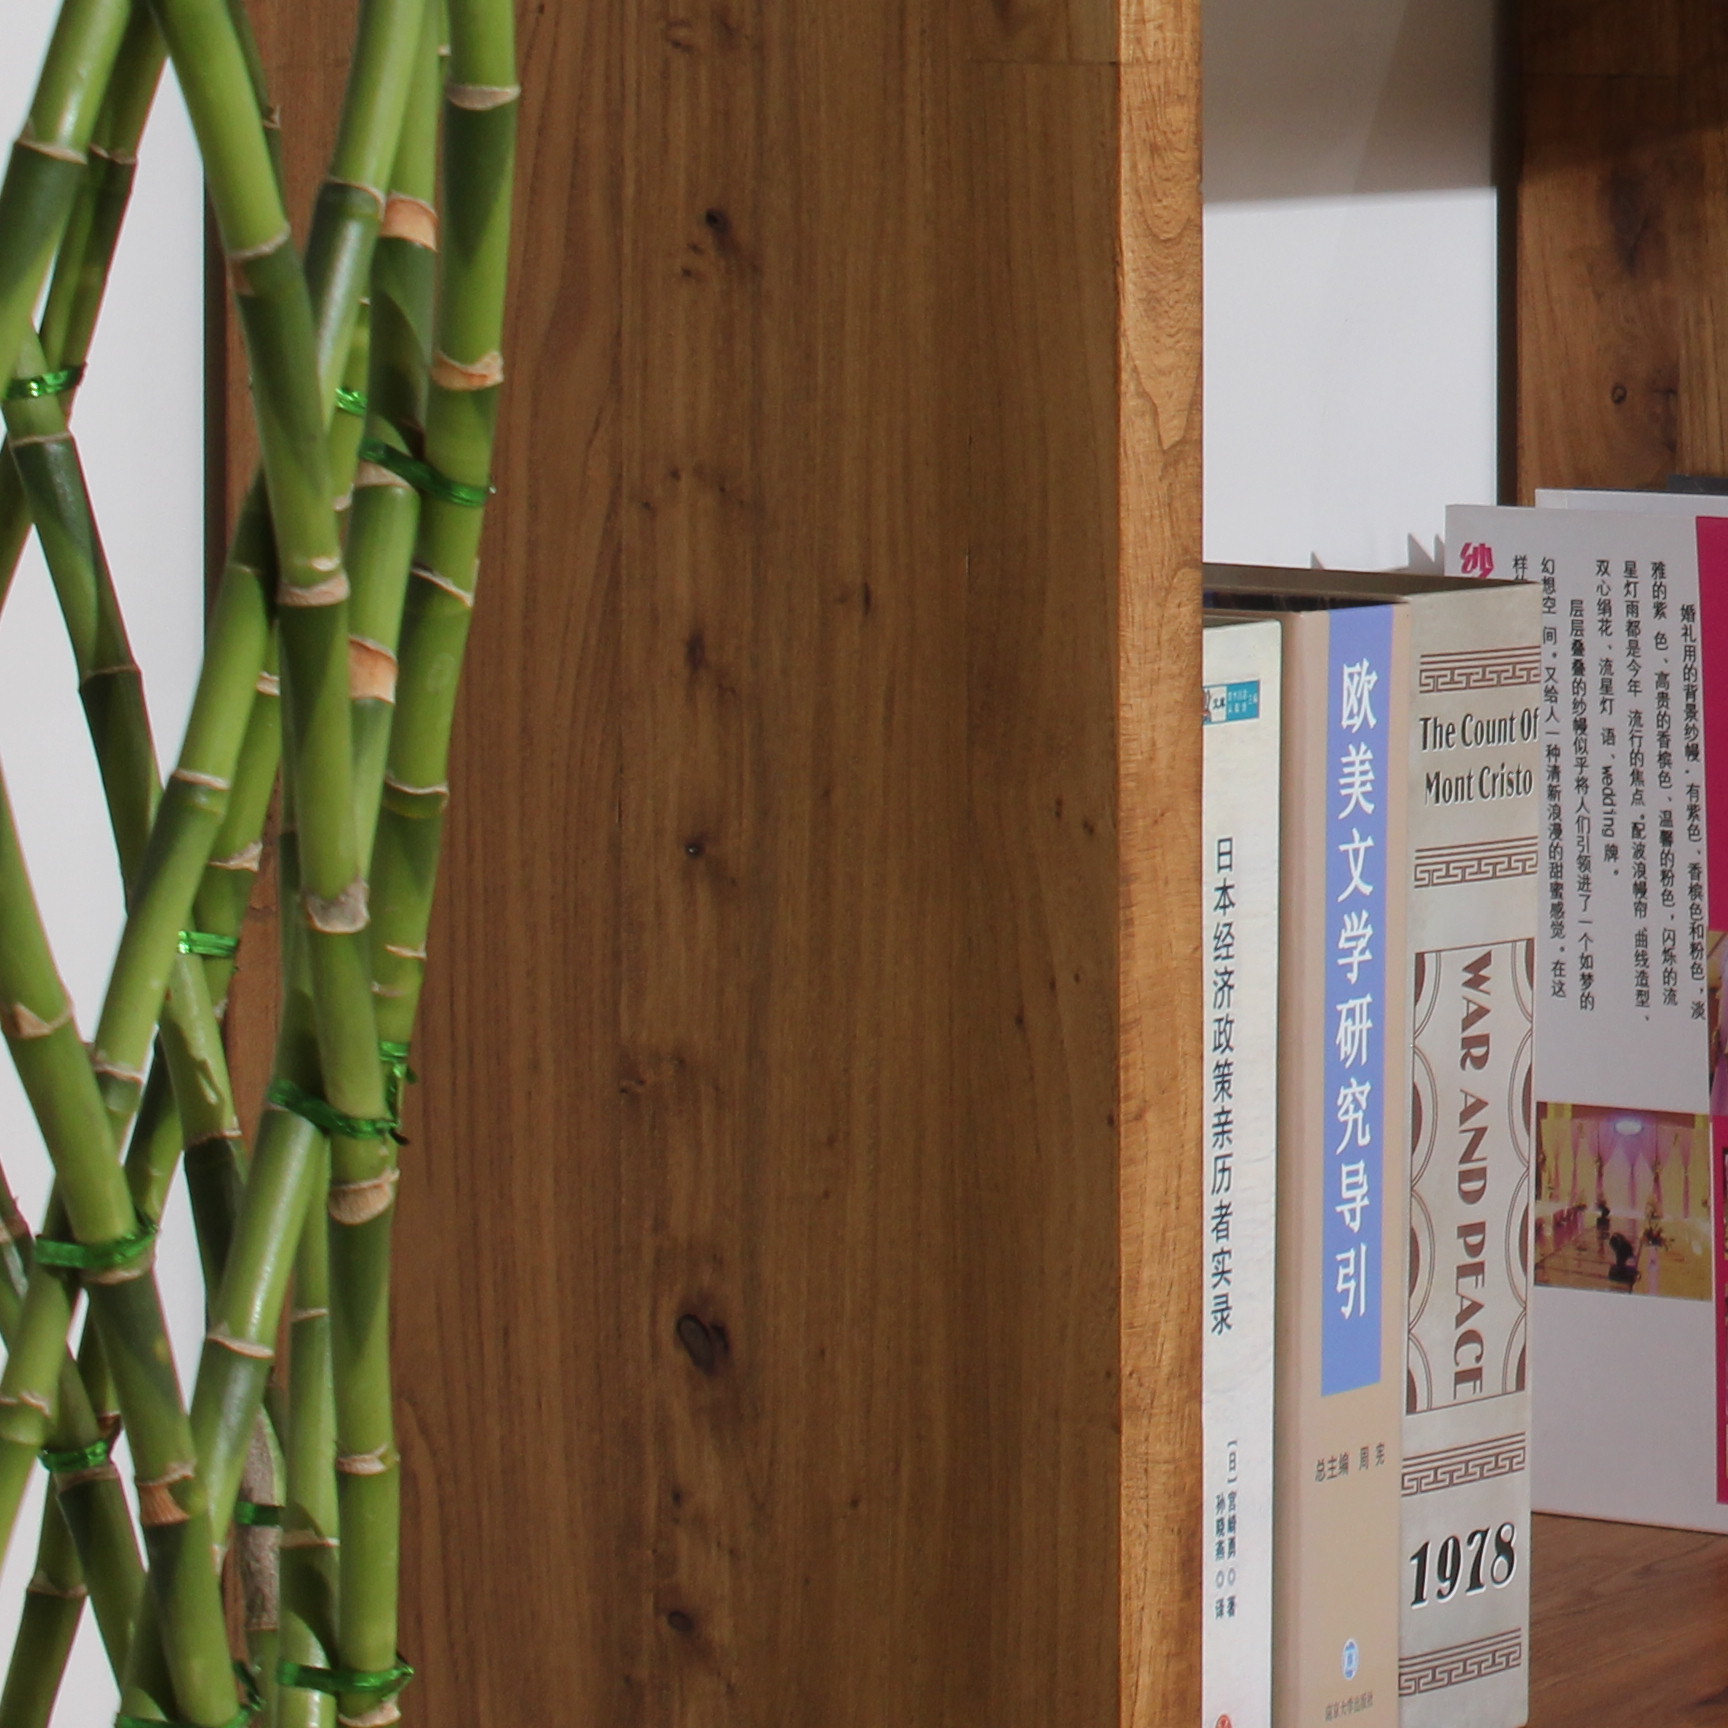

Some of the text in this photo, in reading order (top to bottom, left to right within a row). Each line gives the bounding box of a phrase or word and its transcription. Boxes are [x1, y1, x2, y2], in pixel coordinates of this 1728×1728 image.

[1419, 706, 1540, 751] The Count Of
[1425, 762, 1533, 806] Mont Cristo
[1210, 836, 1235, 1335] 日本经济政策亲历者实录
[1334, 656, 1378, 1319] 欧美文学研究导引
[1452, 949, 1493, 1403] WAR AND PEACE
[1408, 1520, 1516, 1609] 1978
